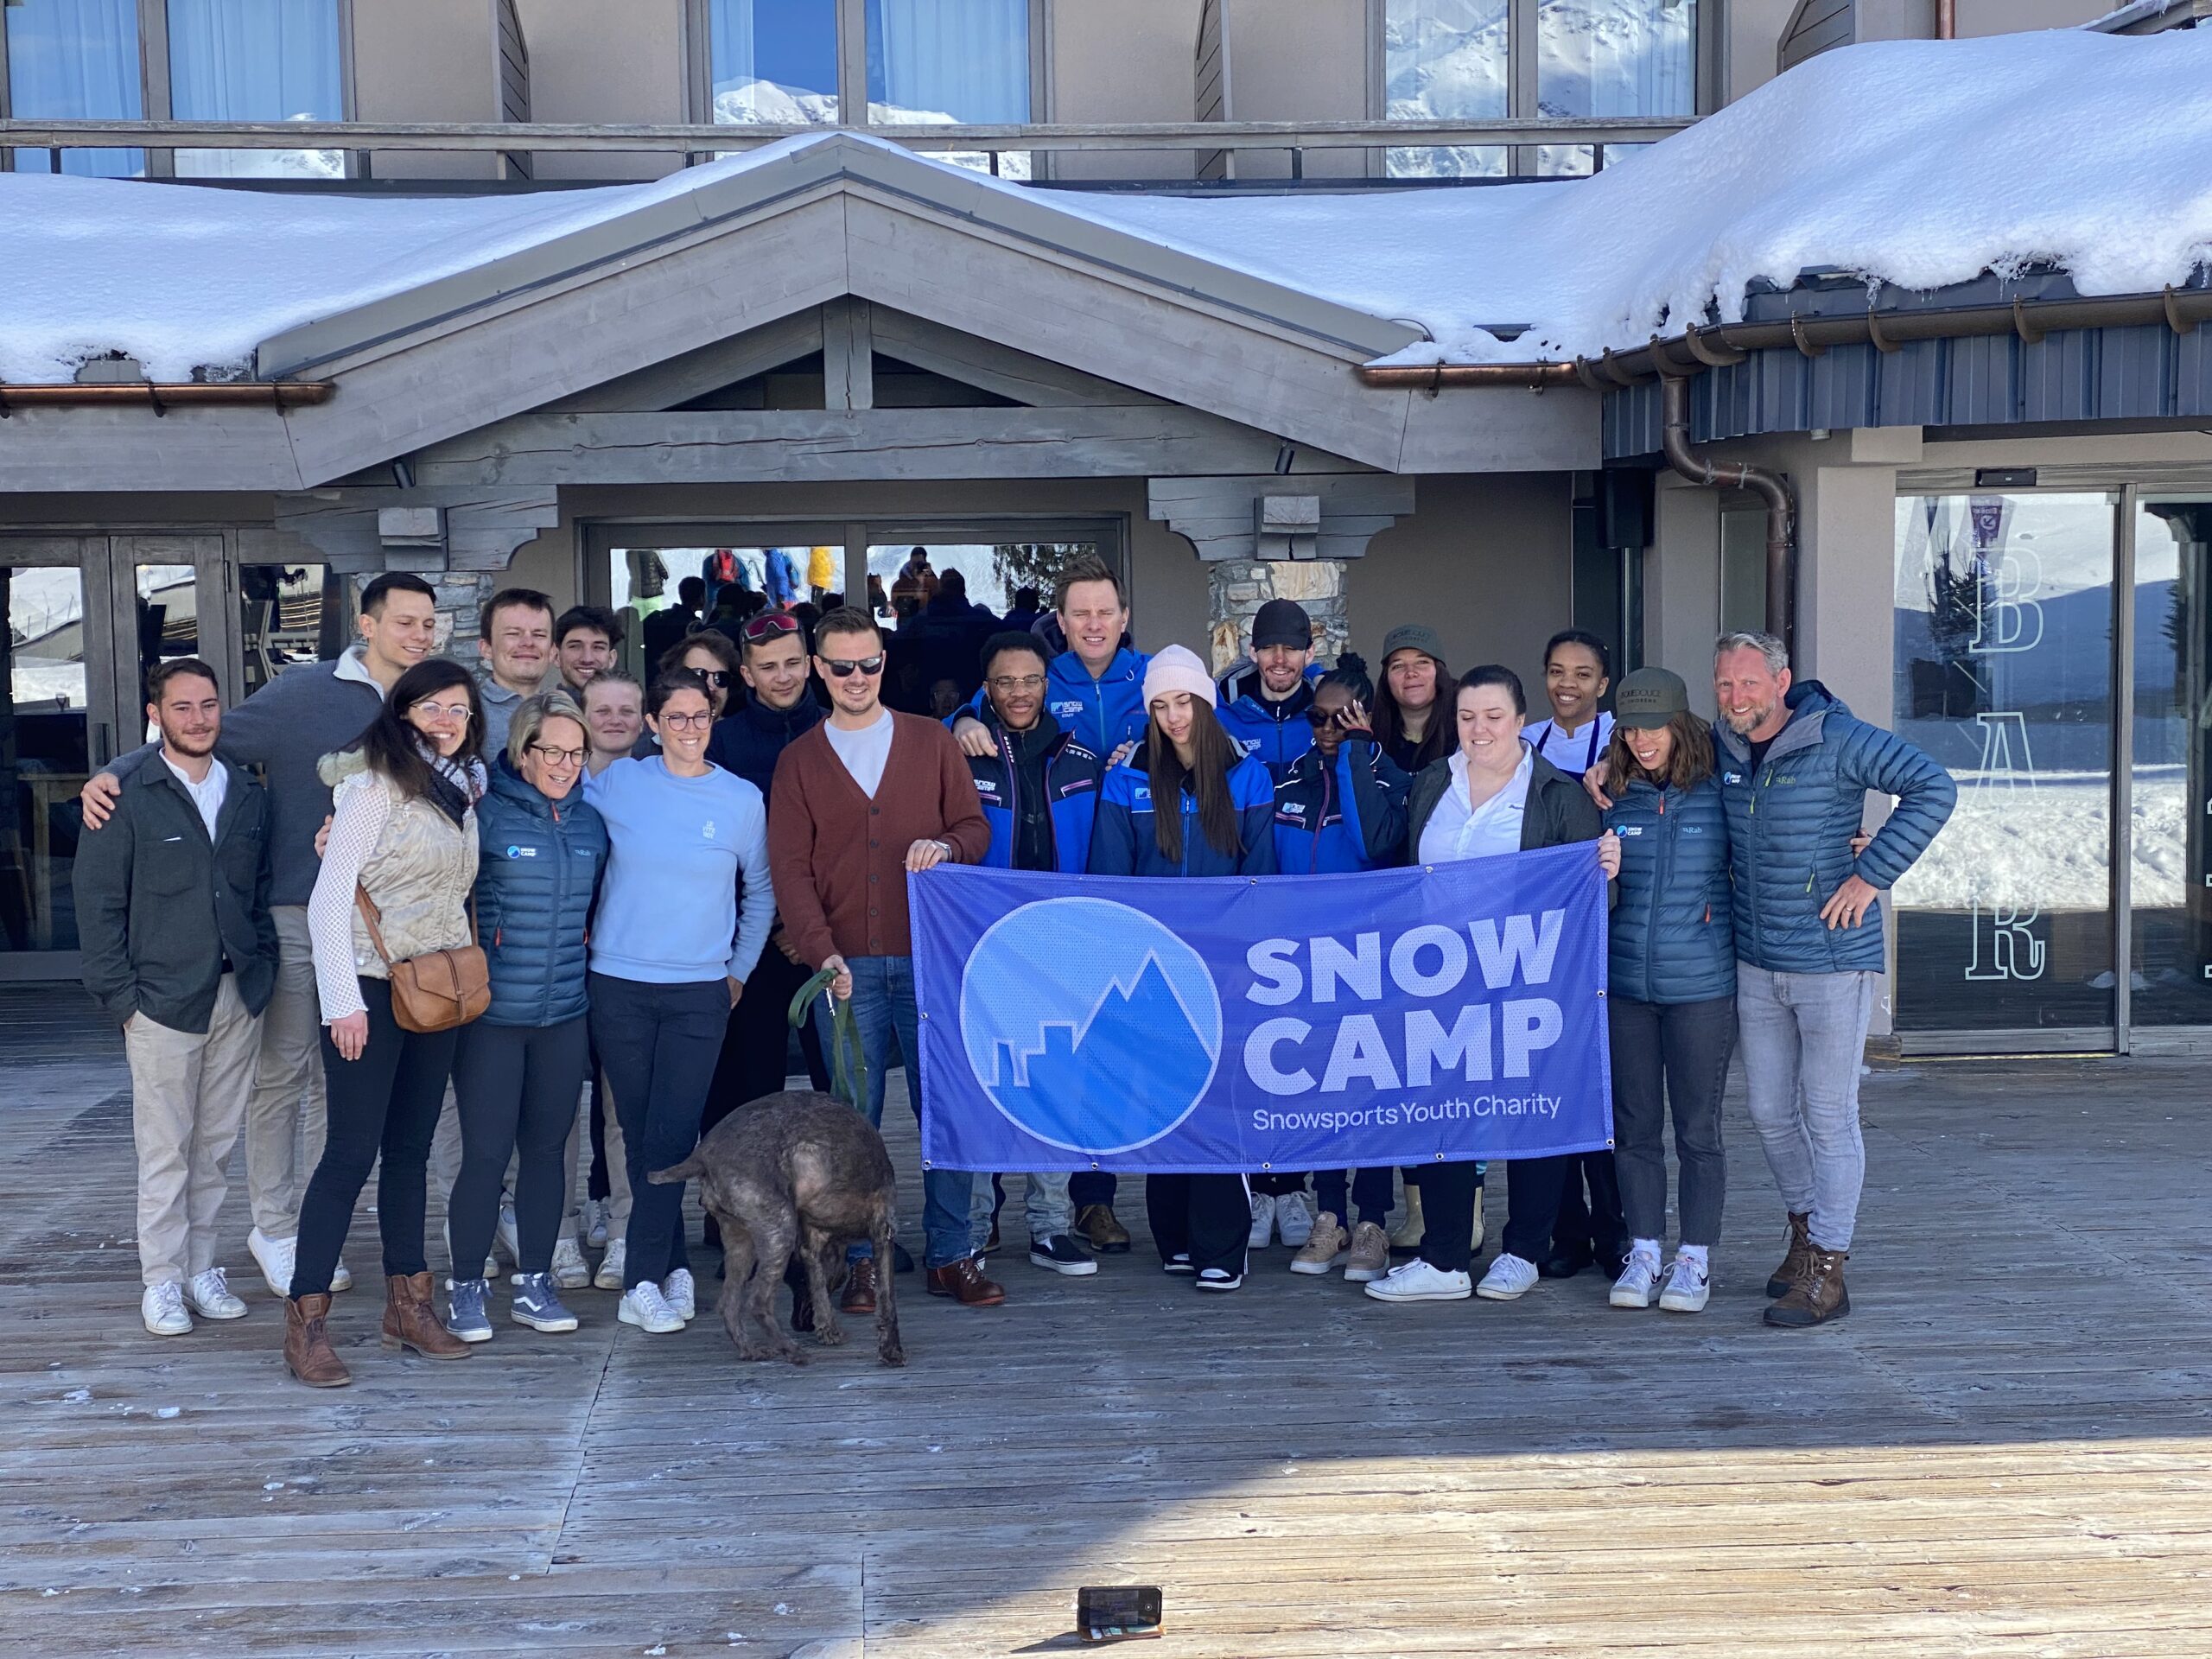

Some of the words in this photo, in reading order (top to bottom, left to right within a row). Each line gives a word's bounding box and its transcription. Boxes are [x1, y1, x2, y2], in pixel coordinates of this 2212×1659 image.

[1245, 908, 1566, 1007] SNOW
[1243, 997, 1564, 1096] CAMP
[1252, 1104, 1399, 1134] Snowsports
[1400, 1097, 1471, 1124] Youth
[1472, 1092, 1561, 1119] Charity
